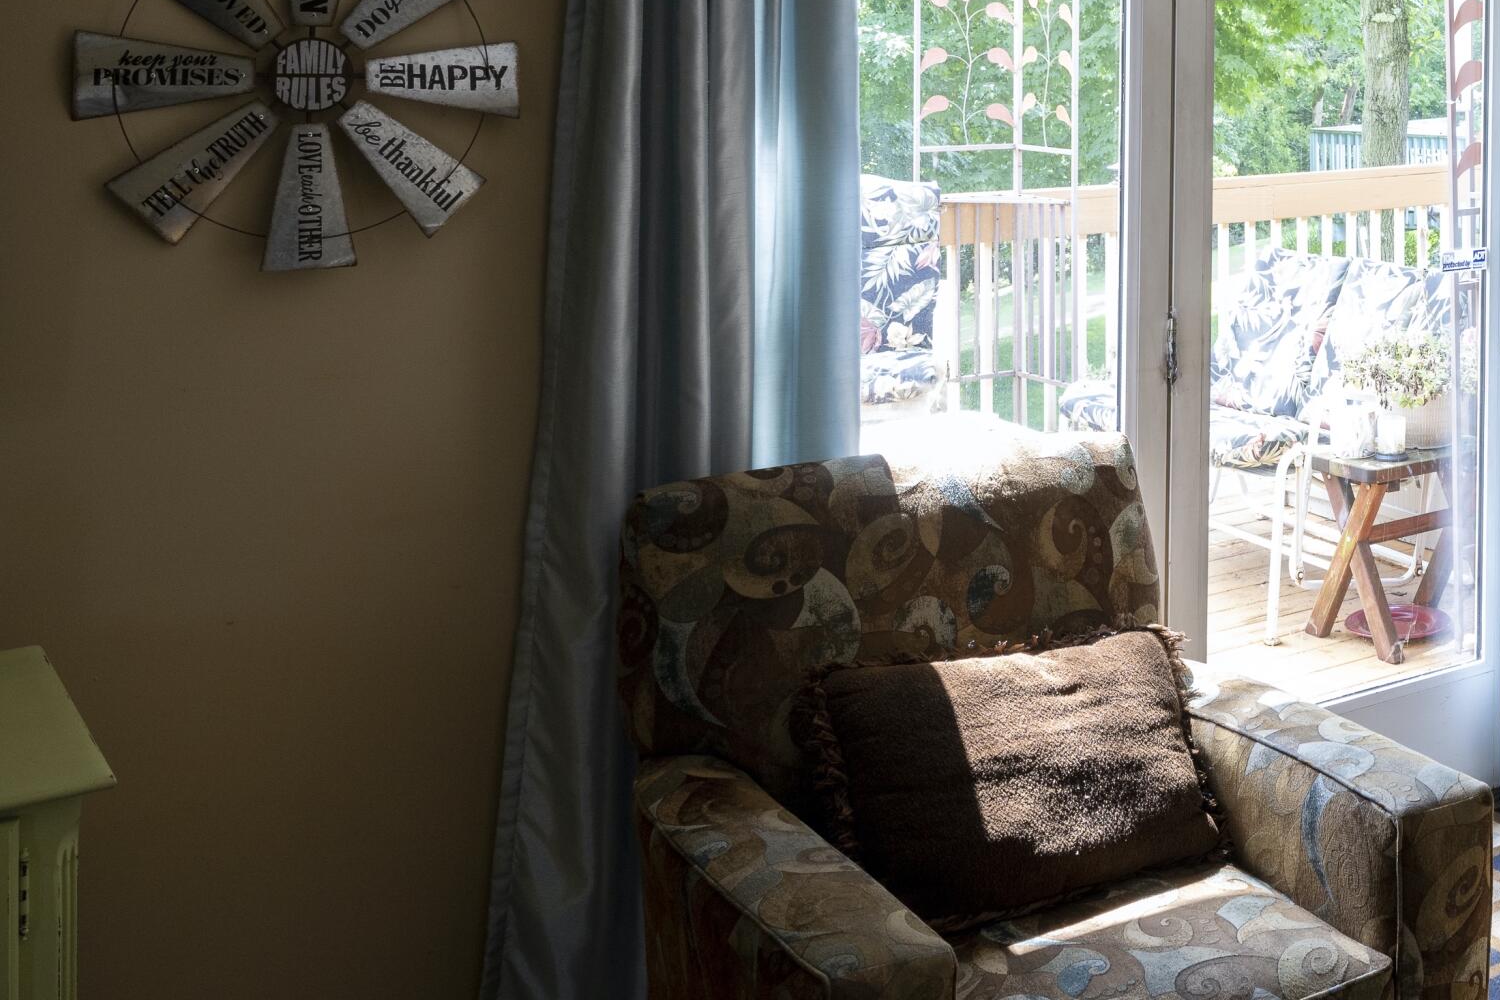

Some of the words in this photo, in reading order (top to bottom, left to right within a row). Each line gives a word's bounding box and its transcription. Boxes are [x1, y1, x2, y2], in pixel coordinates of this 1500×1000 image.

[354, 5, 392, 39] DO
[118, 50, 169, 70] keep
[170, 54, 219, 77] your
[276, 39, 346, 74] FAMILY
[92, 67, 241, 87] PROMISES
[276, 76, 346, 111] RULES
[379, 62, 406, 89] BE
[407, 63, 507, 91] HAPPY
[141, 174, 190, 219] TELL
[206, 111, 268, 167] TRUTH
[298, 132, 322, 174] LOVE
[348, 119, 382, 146] be
[378, 136, 464, 213] thankful
[297, 206, 323, 262] OTHER
